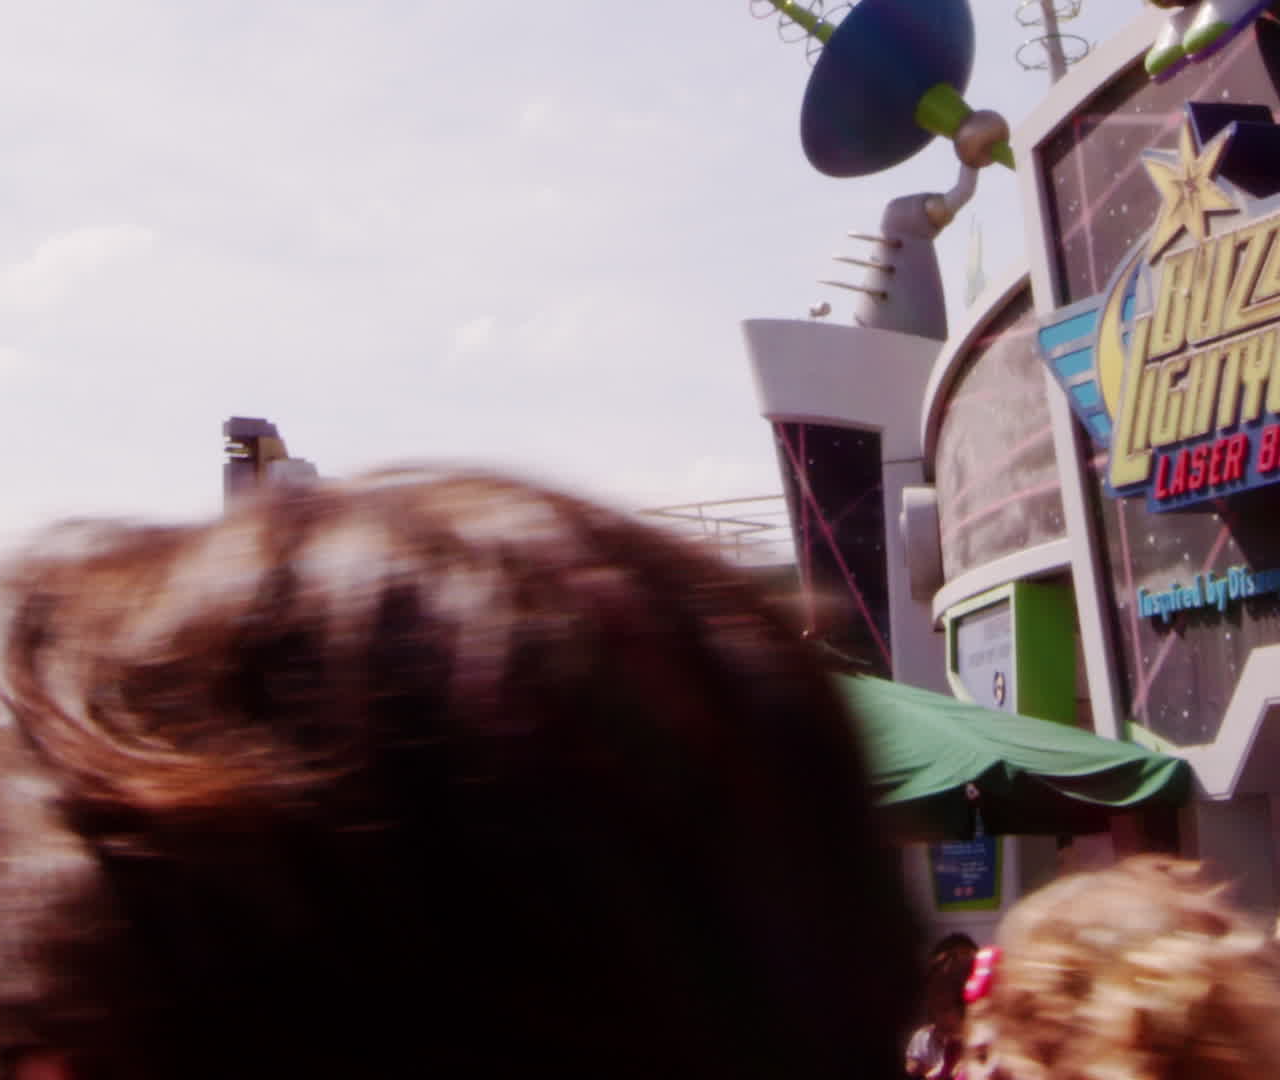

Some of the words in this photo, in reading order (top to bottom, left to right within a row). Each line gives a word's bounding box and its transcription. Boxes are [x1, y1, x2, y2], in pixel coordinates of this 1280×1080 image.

[1153, 433, 1248, 500] LASER
[1137, 573, 1202, 623] Inspired
[1205, 571, 1228, 612] by
